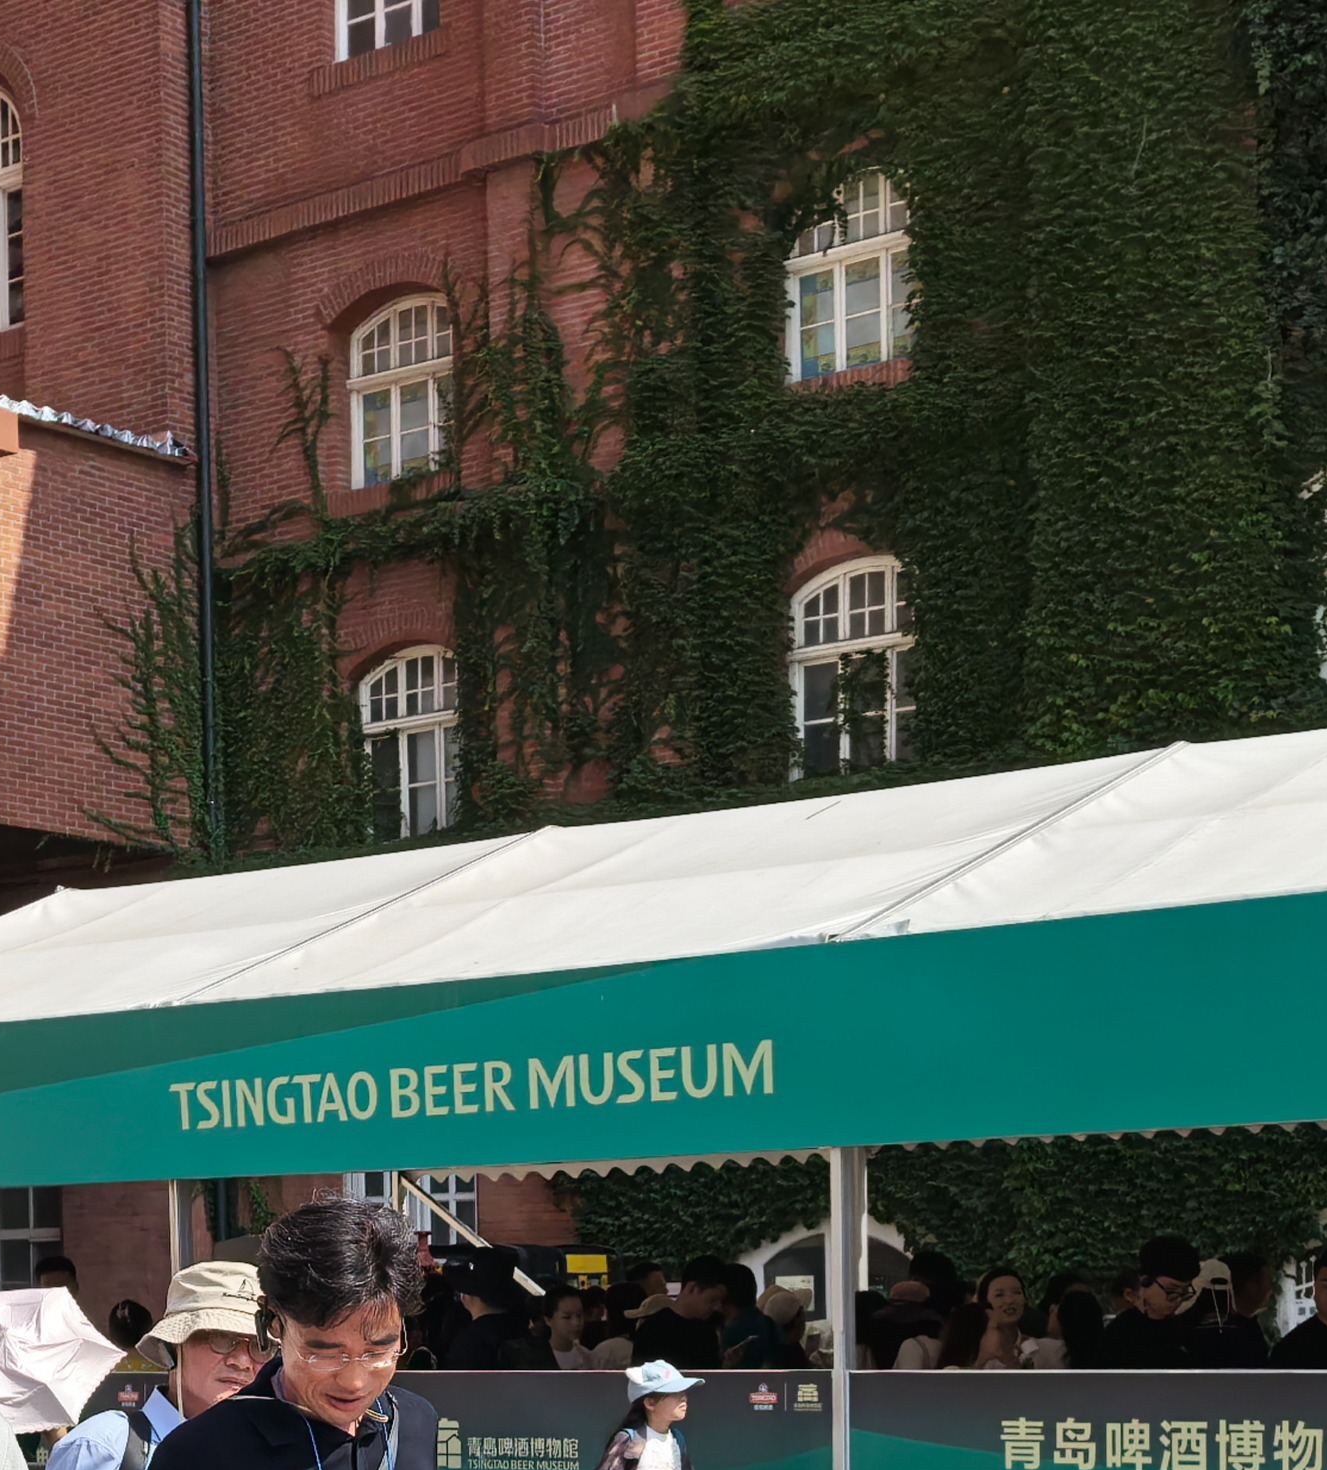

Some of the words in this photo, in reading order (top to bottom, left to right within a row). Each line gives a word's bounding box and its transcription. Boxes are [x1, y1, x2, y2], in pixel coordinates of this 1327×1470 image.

[170, 1070, 378, 1131] TSINGTAO
[391, 1060, 516, 1119] BEER
[528, 1039, 774, 1110] MUSEUM
[468, 1458, 509, 1470] TSINGTAO
[510, 1459, 534, 1470] BEER
